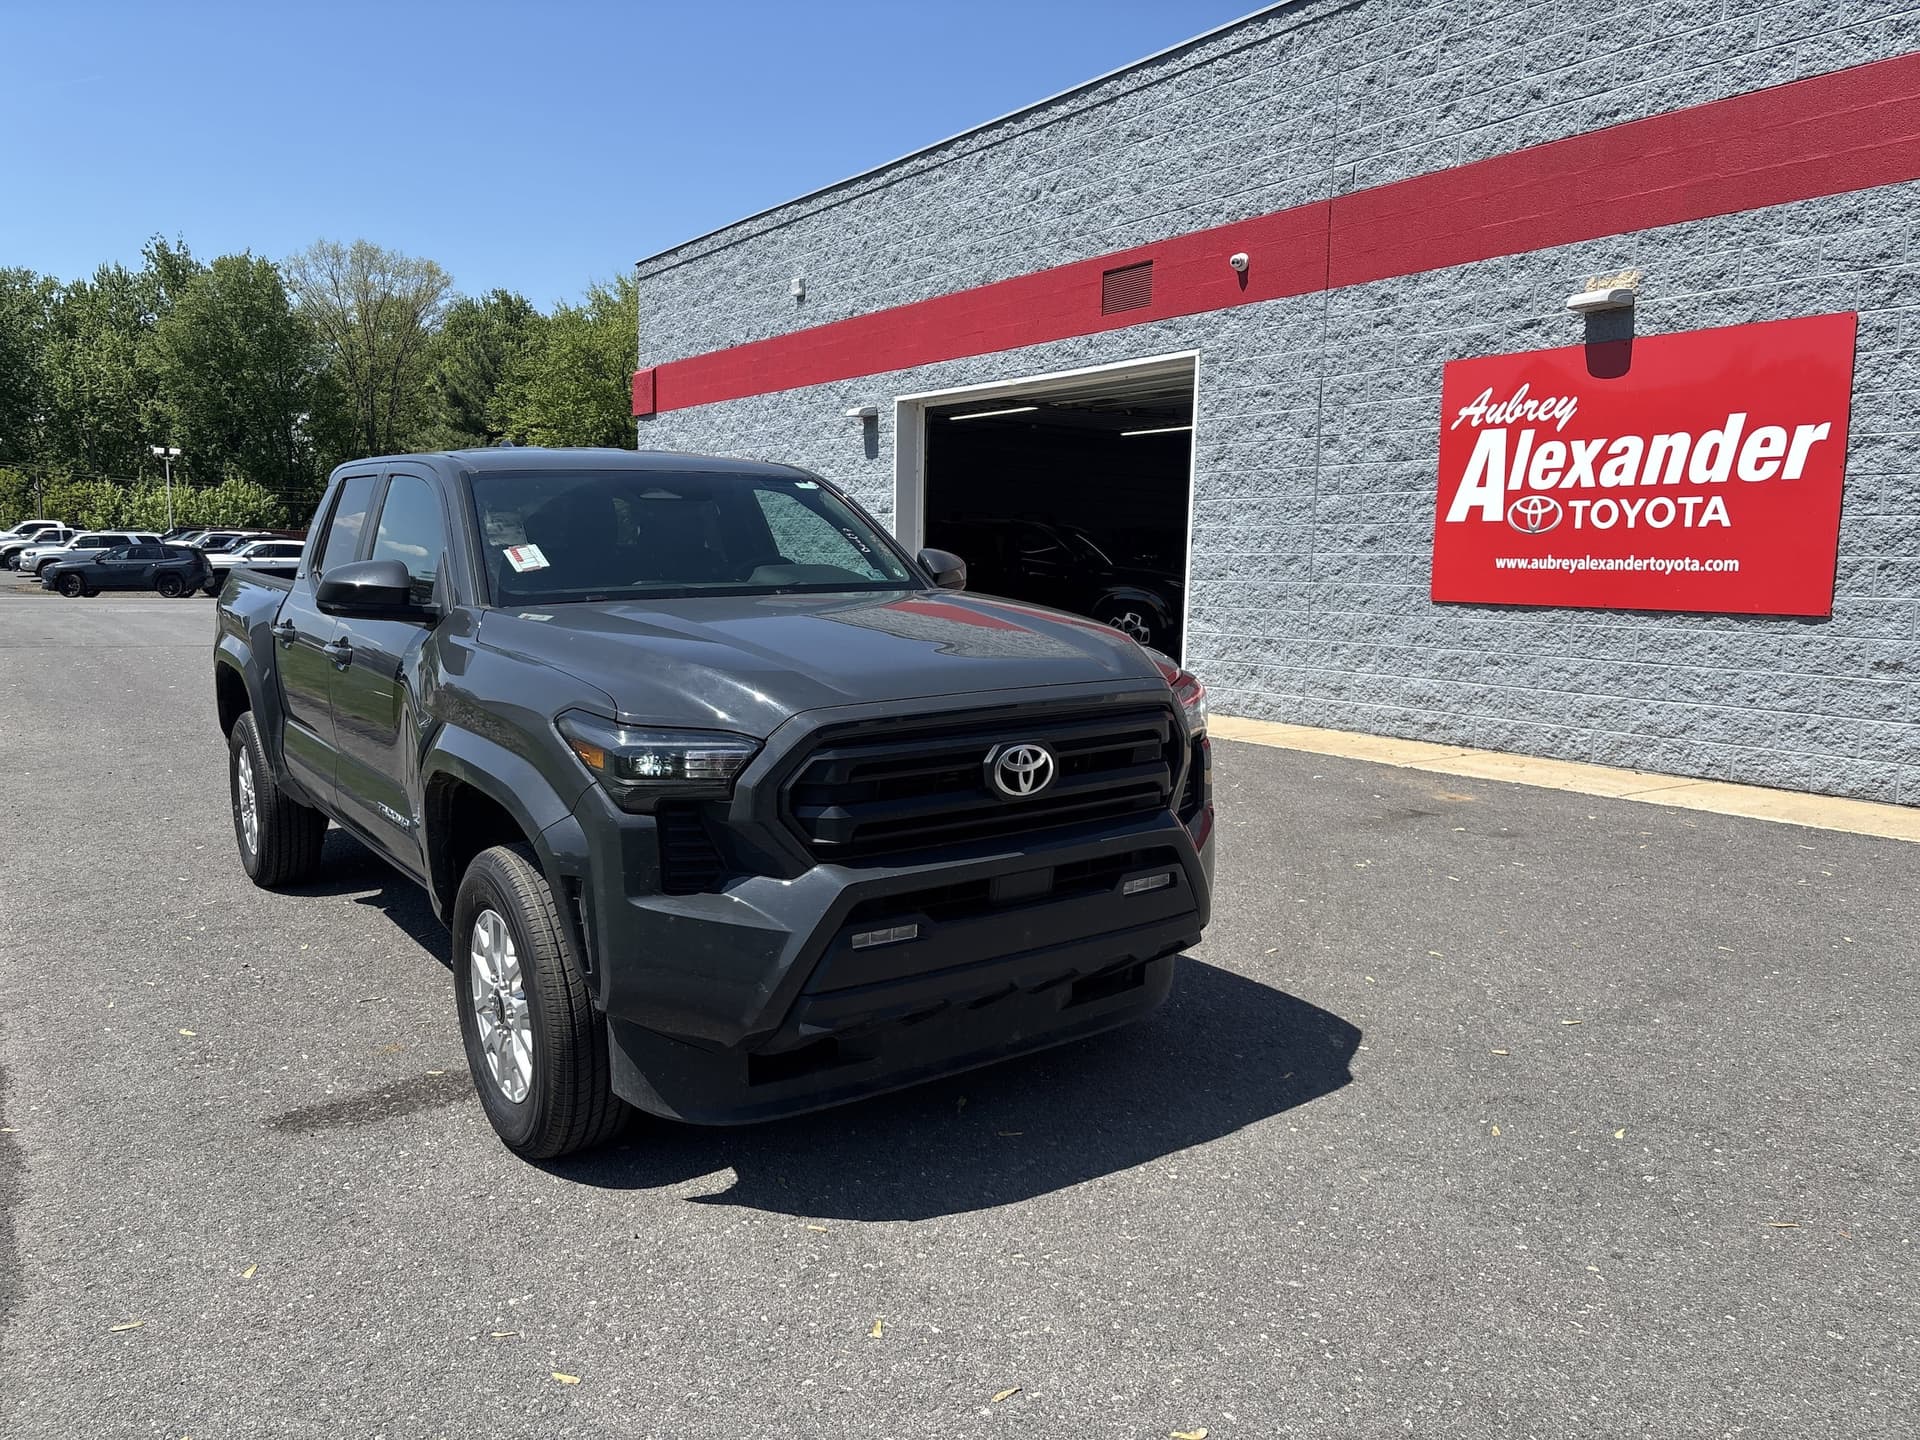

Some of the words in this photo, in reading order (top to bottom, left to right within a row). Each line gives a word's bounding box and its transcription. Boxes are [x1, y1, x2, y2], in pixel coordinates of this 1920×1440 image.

[1451, 383, 1578, 432] Aubrey
[1445, 412, 1832, 523] Alexander
[1568, 496, 1732, 530] TOYOTA
[1495, 554, 1740, 575] www.aubreyalexandertoyota.com
